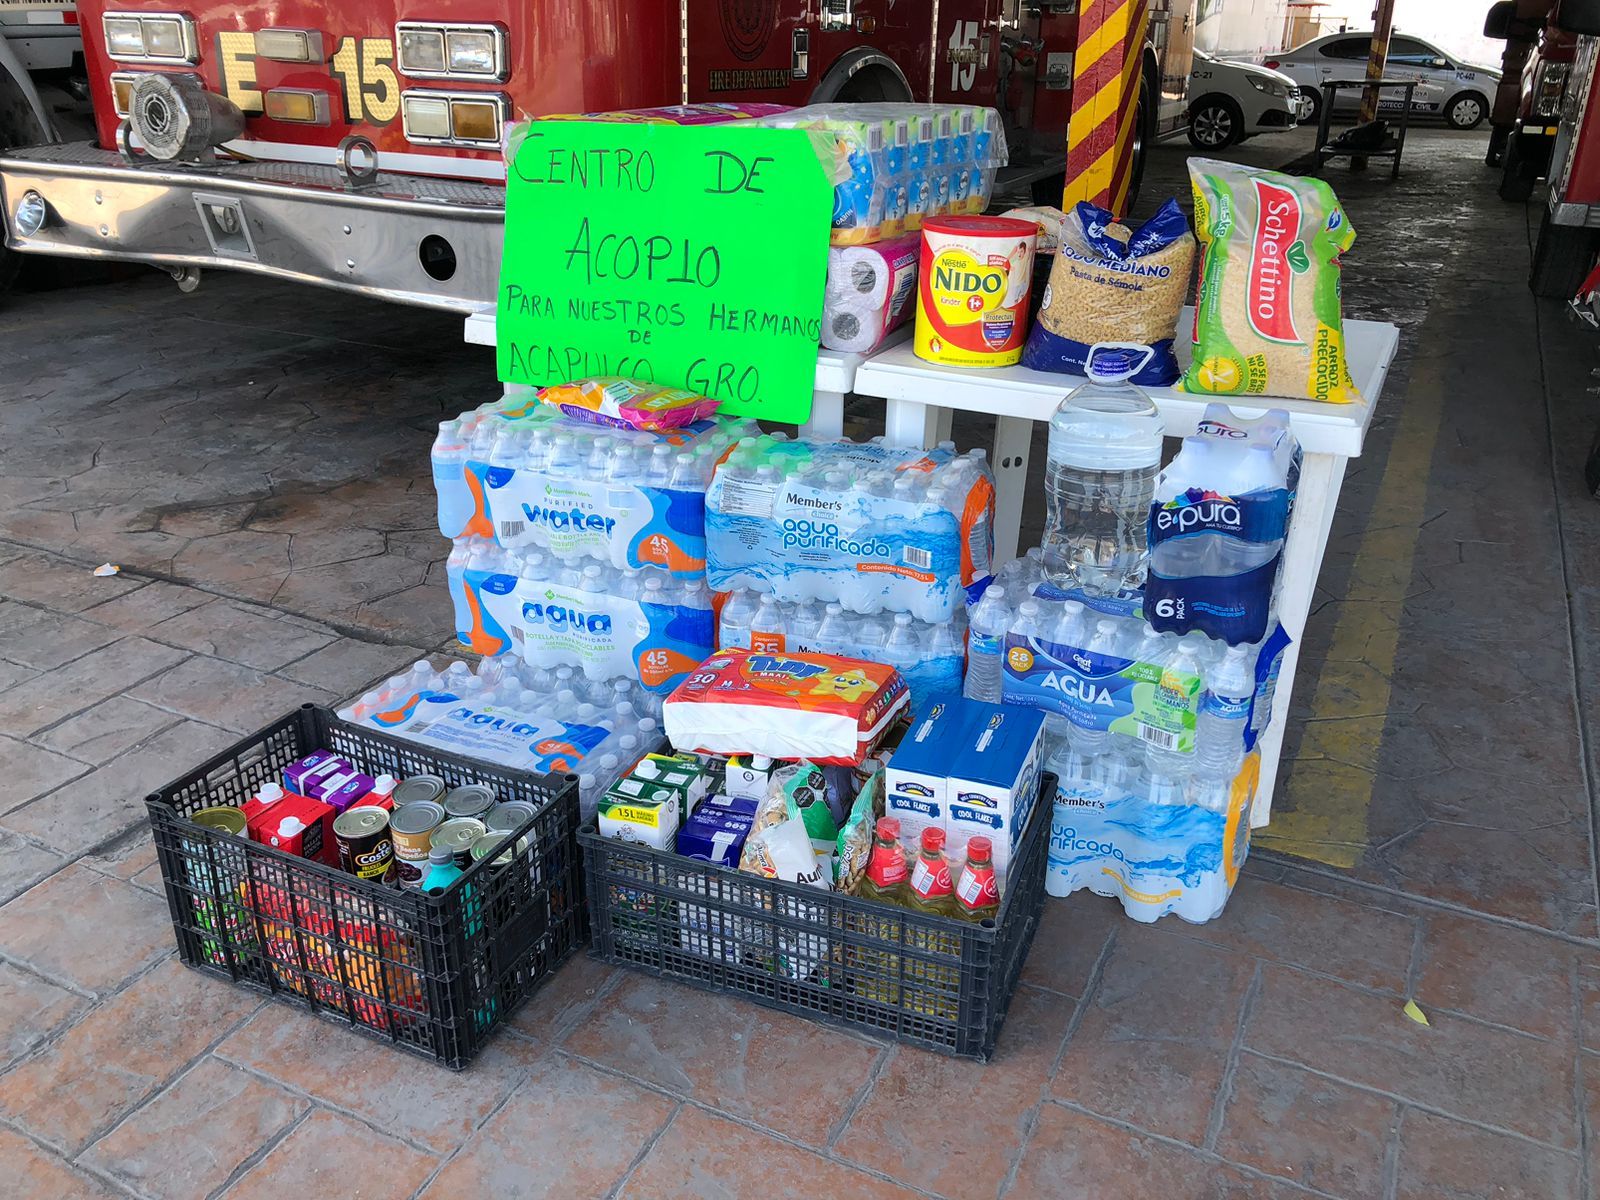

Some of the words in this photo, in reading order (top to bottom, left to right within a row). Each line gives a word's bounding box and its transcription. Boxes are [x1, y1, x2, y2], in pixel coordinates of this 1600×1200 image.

[948, 20, 979, 91] 15
[217, 31, 264, 113] E
[332, 36, 400, 122] 15
[709, 69, 732, 91] FIRE
[732, 69, 790, 89] DEPARTMENT
[1191, 71, 1213, 79] C-21
[513, 133, 655, 193] CENTRO
[703, 150, 775, 194] DE
[564, 216, 721, 288] ACOPIO
[1258, 199, 1289, 320] Schettino
[941, 258, 968, 269] Nestlé
[1098, 258, 1171, 279] MEDIANO
[935, 265, 1002, 293] NIDO
[1070, 266, 1092, 282] Pasta
[1094, 274, 1106, 284] de
[1108, 277, 1144, 292] Sémola
[506, 284, 556, 320] PARA
[568, 299, 686, 328] NUESTROS
[709, 302, 821, 343] HERMANOS
[627, 329, 651, 345] DE
[1061, 355, 1077, 365] Cont.
[1247, 356, 1256, 367] NI
[1255, 354, 1265, 367] NO
[1316, 329, 1329, 401] PRECOCIDO
[1328, 345, 1339, 389] ARROZ
[685, 357, 764, 404] GRO.
[1249, 368, 1258, 378] SE
[1258, 368, 1266, 379] SE
[543, 497, 594, 510] PURIFIED
[786, 492, 842, 511] Member's
[521, 502, 616, 541] water
[783, 518, 838, 539] agua
[649, 535, 669, 554] 45
[783, 531, 890, 558] purificada
[861, 564, 897, 572] Contenido
[1155, 598, 1175, 618] 6
[1175, 597, 1185, 619] PACK
[522, 602, 612, 635] agua
[646, 651, 668, 665] 45
[1011, 651, 1029, 662] 28
[1072, 653, 1092, 667] Great
[747, 655, 829, 679] Tiny
[689, 673, 716, 685] 30
[721, 680, 733, 688] M
[1040, 670, 1115, 708] AGUA
[1166, 699, 1190, 709] MENOS
[1219, 705, 1243, 713] AGUA
[446, 707, 540, 738] agua
[896, 799, 911, 808] COOL
[912, 800, 931, 813] FLAKES
[1053, 794, 1105, 809] Member's
[630, 809, 636, 819] L
[957, 809, 973, 819] COOL
[974, 811, 994, 824] FLAKES
[1051, 823, 1076, 839] ua
[378, 843, 388, 851] La
[1050, 836, 1124, 862] rificada
